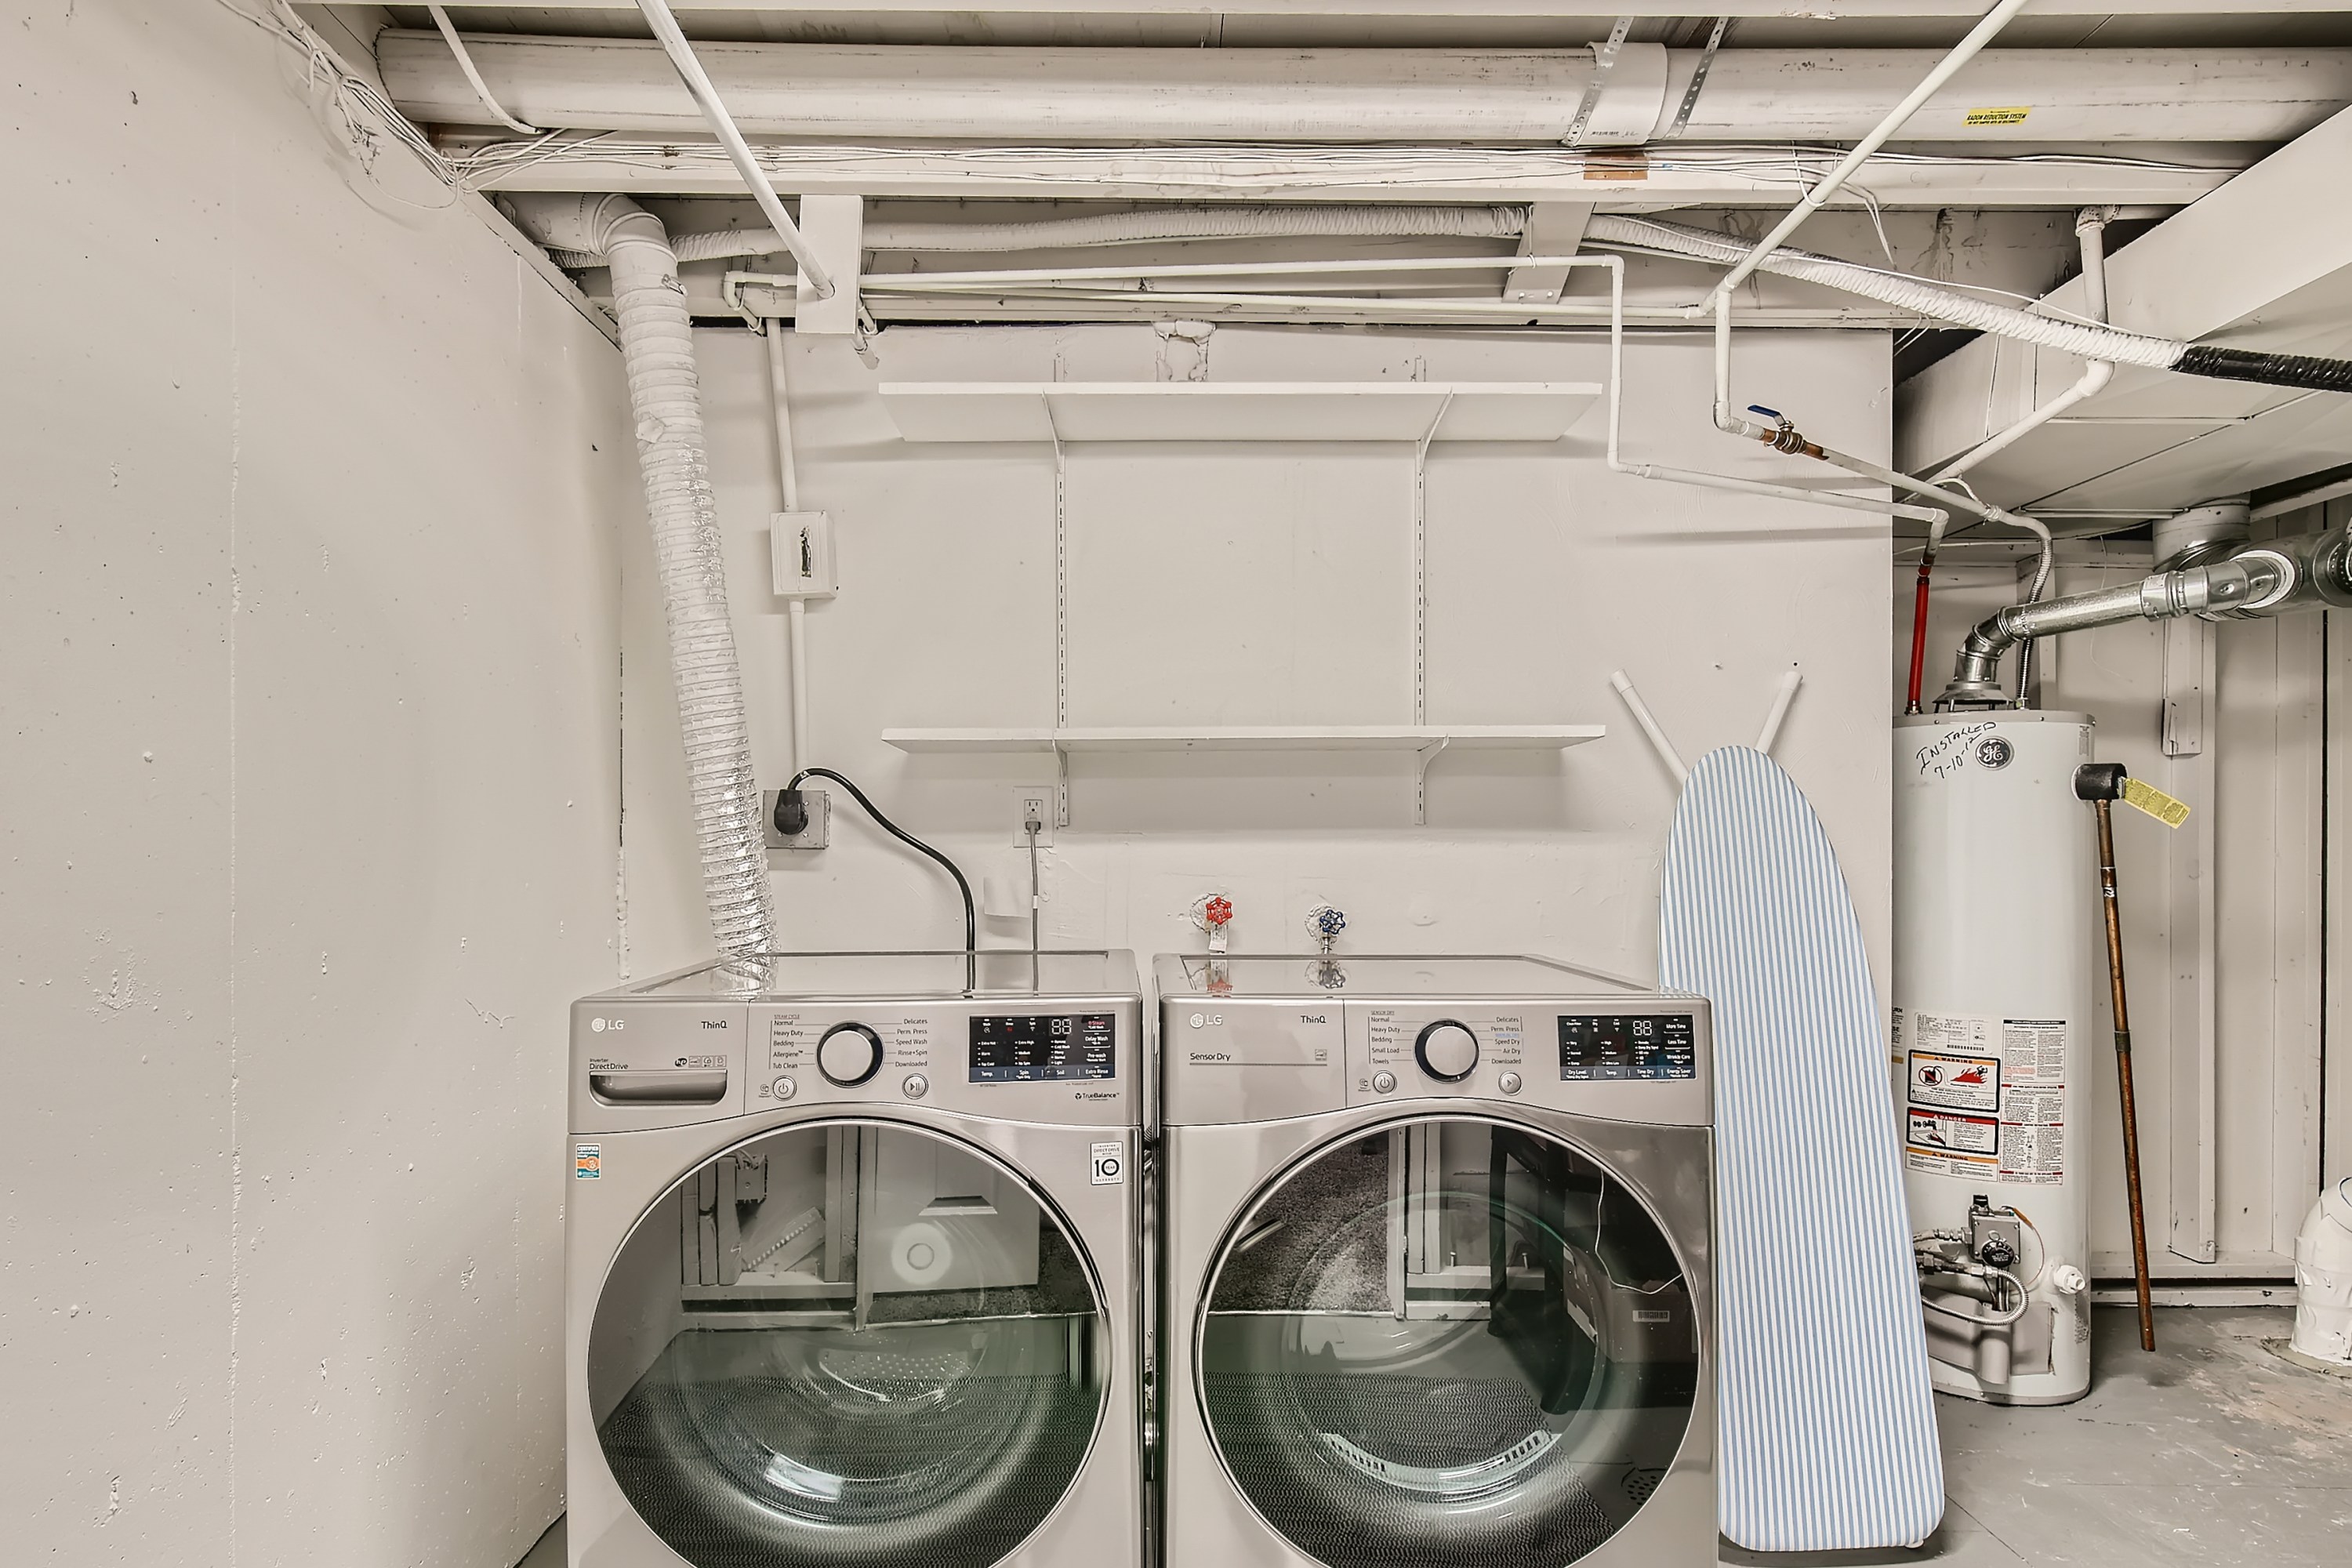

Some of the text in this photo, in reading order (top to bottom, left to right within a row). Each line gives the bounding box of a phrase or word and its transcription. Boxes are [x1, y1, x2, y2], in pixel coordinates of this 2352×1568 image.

[1916, 721, 1996, 775] INSTALLED
[608, 1019, 625, 1030] LG
[1207, 1014, 1223, 1025] LG
[1301, 1015, 1327, 1024] ThinQ
[701, 1021, 728, 1029] ThinQ
[1216, 1053, 1231, 1062] Dry
[1940, 1152, 1969, 1161] WARNING
[1094, 1158, 1120, 1177] 10
